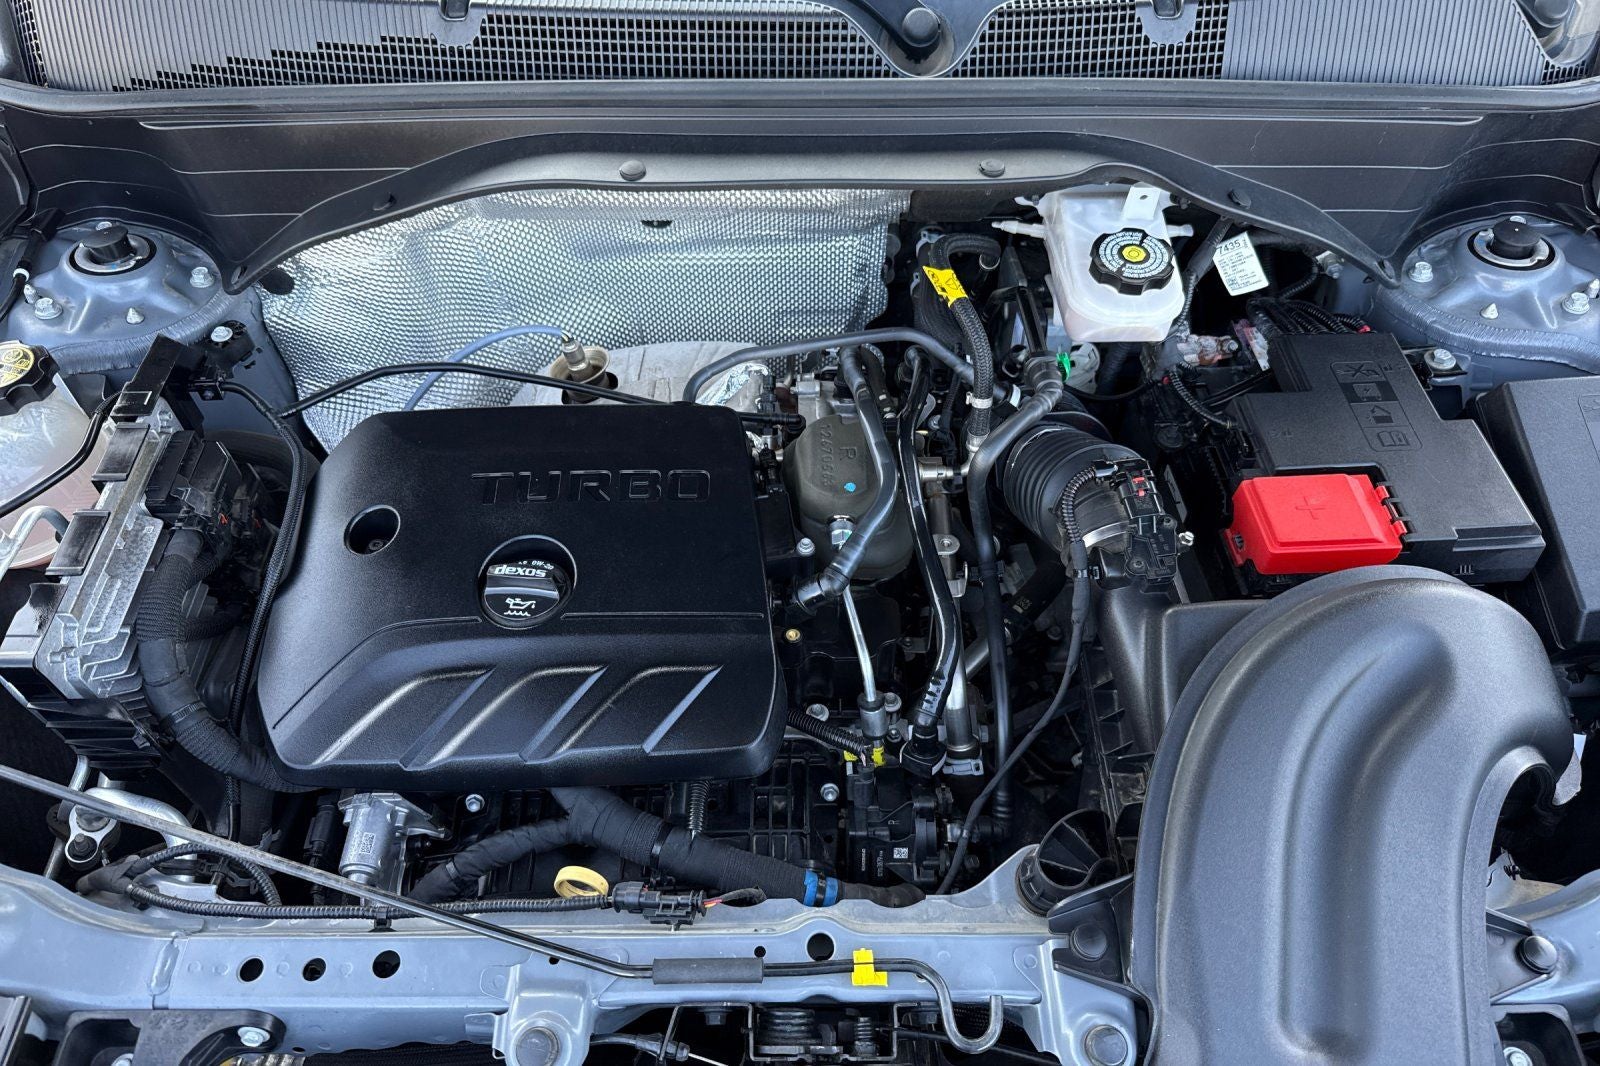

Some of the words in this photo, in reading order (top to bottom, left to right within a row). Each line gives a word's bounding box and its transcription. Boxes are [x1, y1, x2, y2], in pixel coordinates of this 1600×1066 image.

[1217, 239, 1241, 254] 7435
[471, 469, 711, 505] TURBO
[494, 564, 548, 578] dexos
